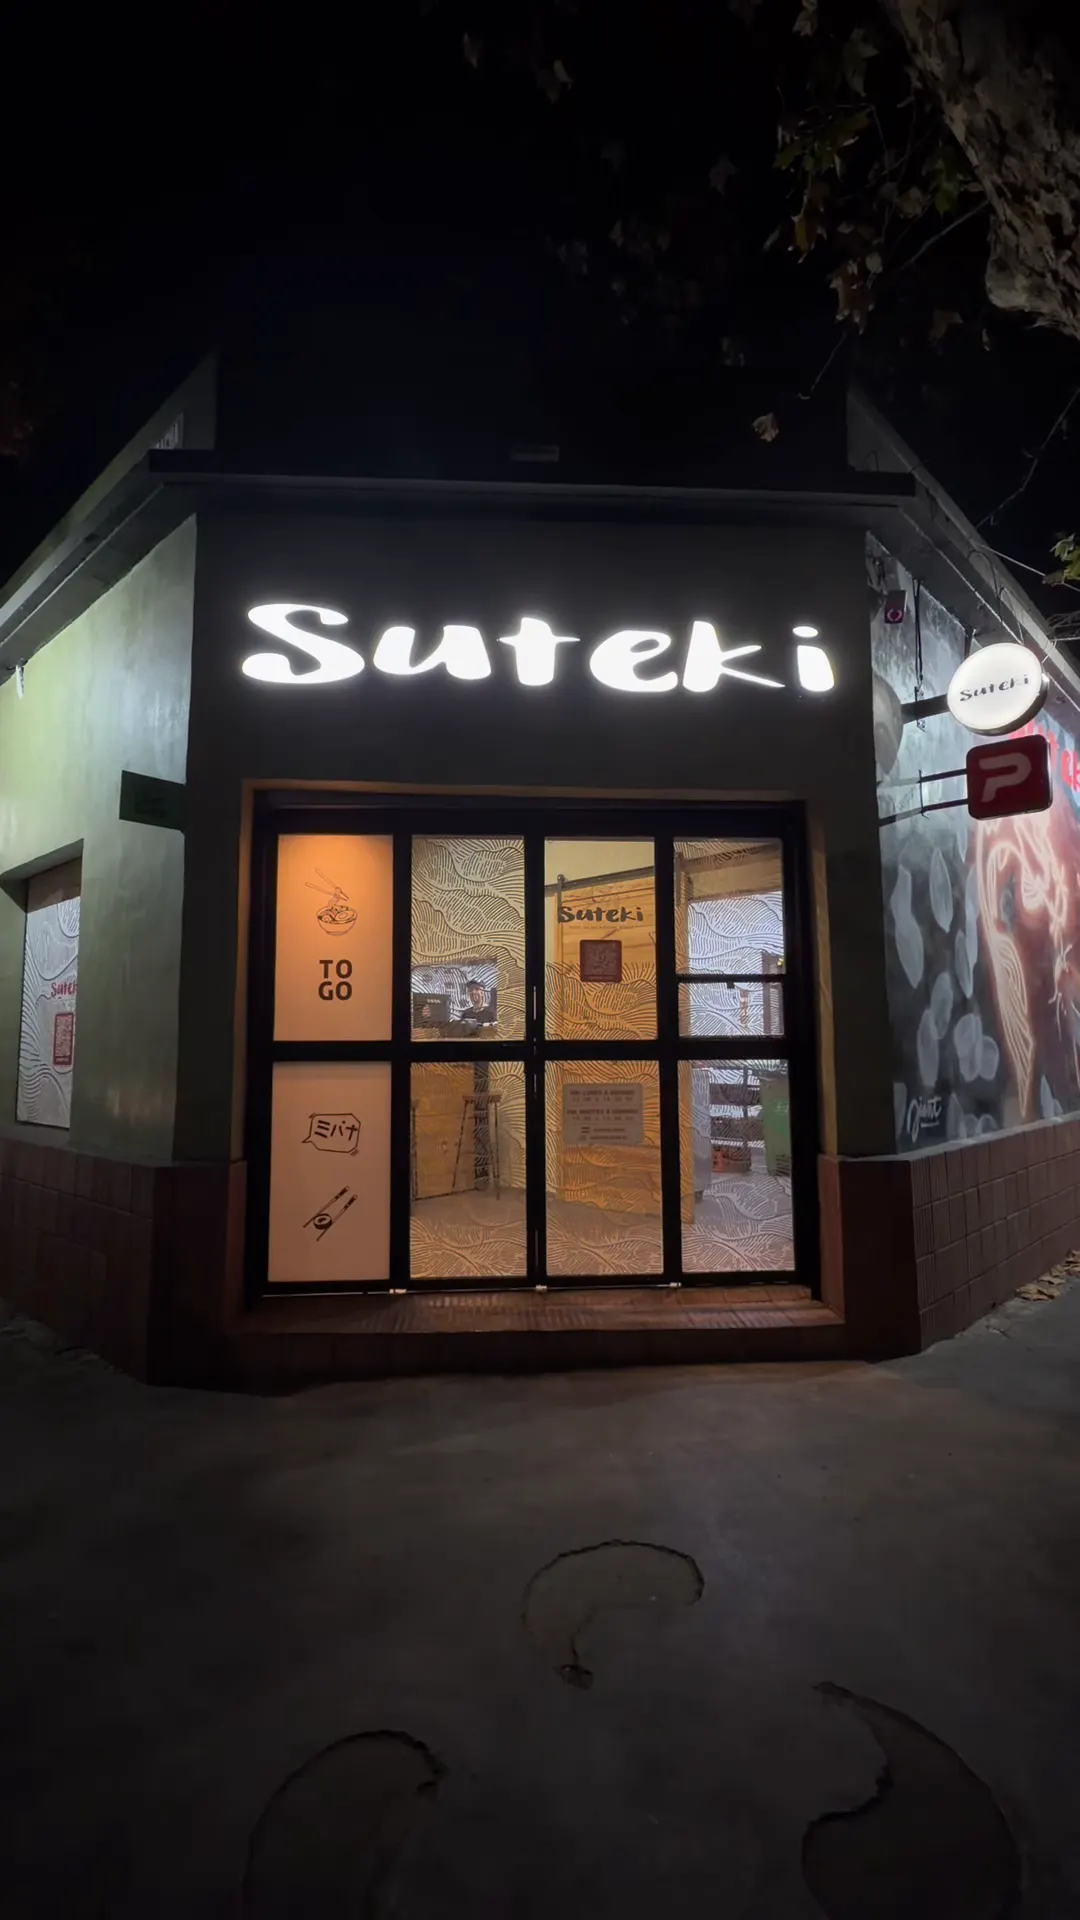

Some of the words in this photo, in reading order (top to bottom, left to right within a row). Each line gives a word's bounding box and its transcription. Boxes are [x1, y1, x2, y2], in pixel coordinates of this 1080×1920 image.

[242, 603, 834, 692] Suteki
[959, 674, 1029, 701] Suteki
[558, 905, 643, 923] Suteki
[319, 959, 353, 978] TO
[318, 981, 353, 1001] GO
